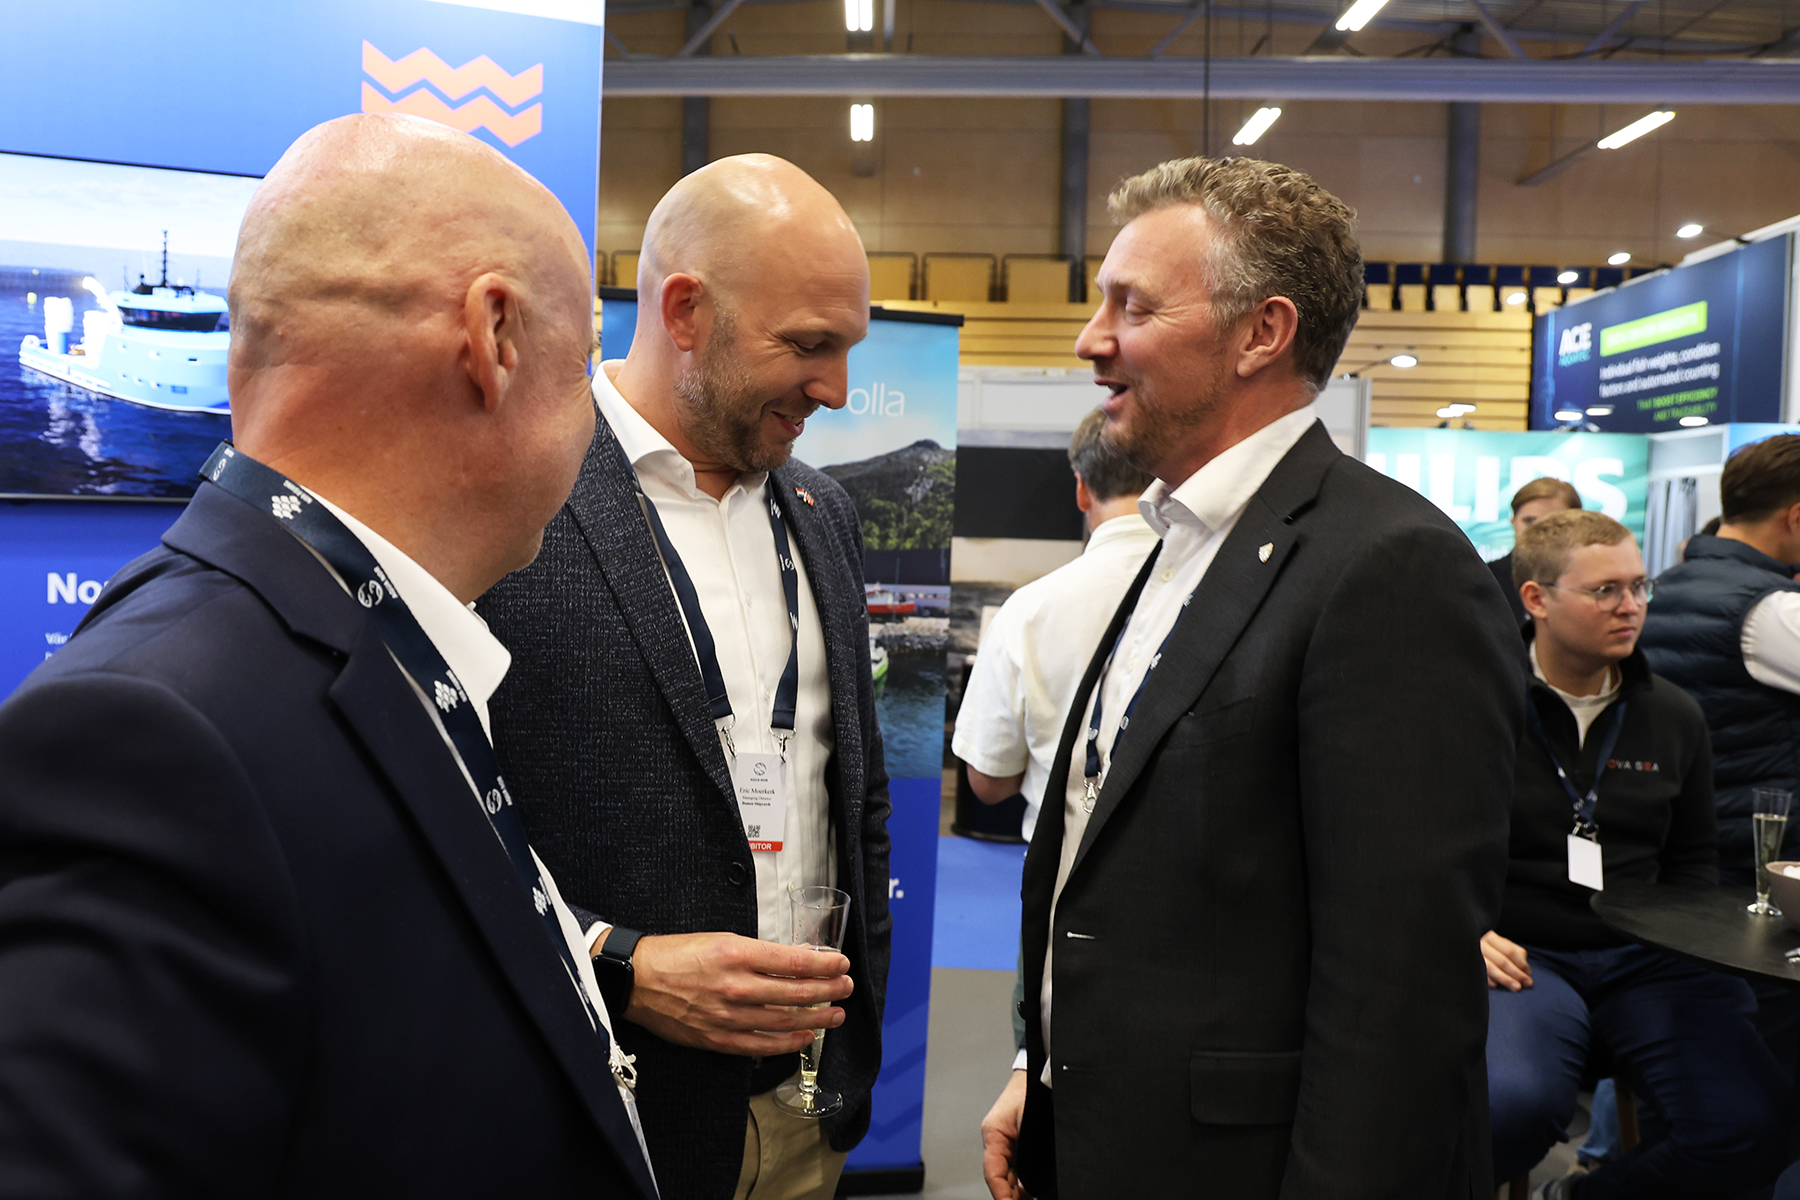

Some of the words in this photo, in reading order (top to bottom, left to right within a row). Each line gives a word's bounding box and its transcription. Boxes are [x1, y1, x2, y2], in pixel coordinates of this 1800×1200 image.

[1559, 322, 1592, 357] ACE
[1679, 342, 1720, 363] condition
[1624, 375, 1640, 393] and
[1640, 368, 1681, 390] automated
[1681, 362, 1721, 381] counting
[845, 382, 905, 416] olla
[47, 572, 109, 605] No
[750, 842, 772, 850] BITOR
[889, 878, 904, 899] r.
